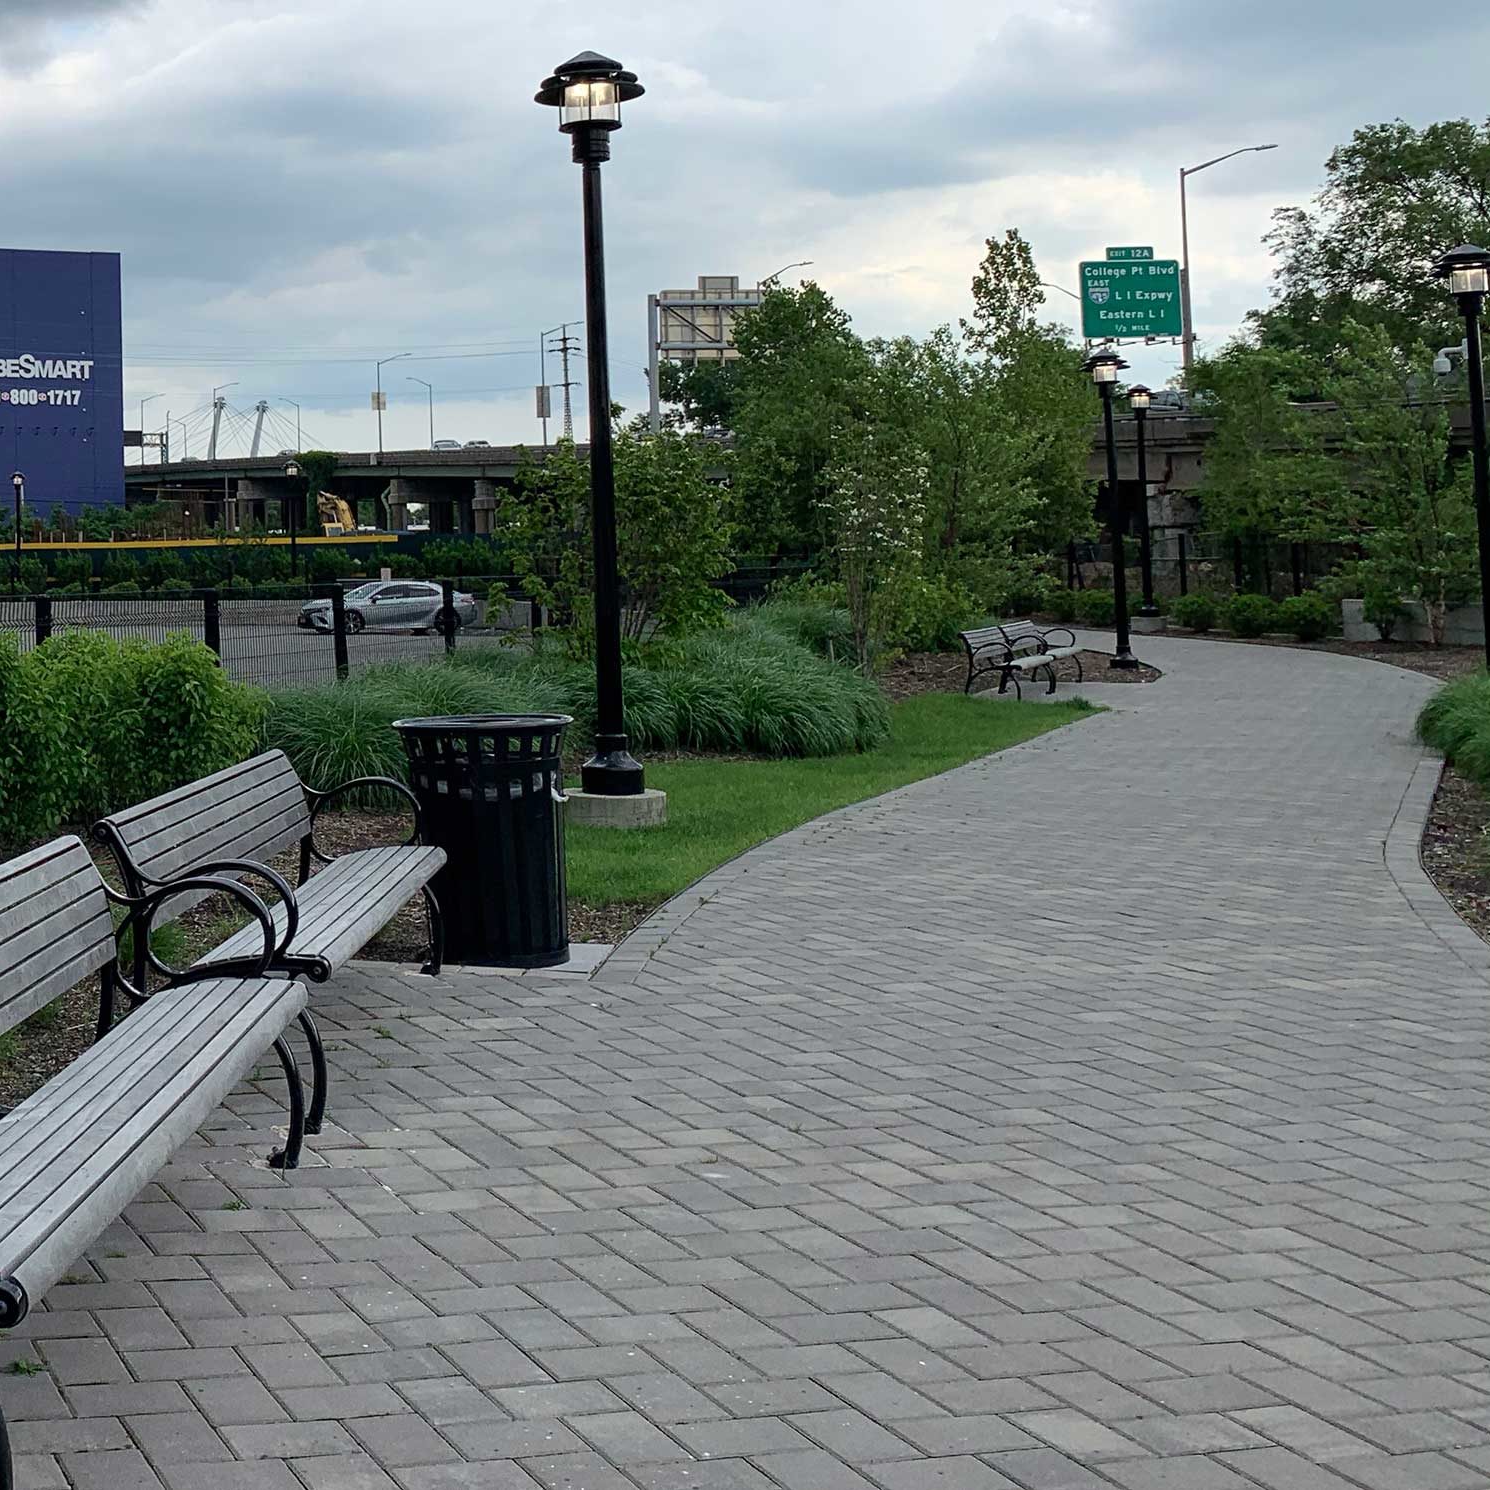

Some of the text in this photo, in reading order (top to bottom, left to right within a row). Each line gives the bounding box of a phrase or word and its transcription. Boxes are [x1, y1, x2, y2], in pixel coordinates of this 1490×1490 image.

[1131, 249, 1150, 257] 12A
[1085, 265, 1175, 278] College Pt Blvd
[1115, 291, 1122, 300] L
[1135, 291, 1173, 302] Expwy
[1099, 310, 1144, 319] Eastern
[1149, 310, 1156, 318] L
